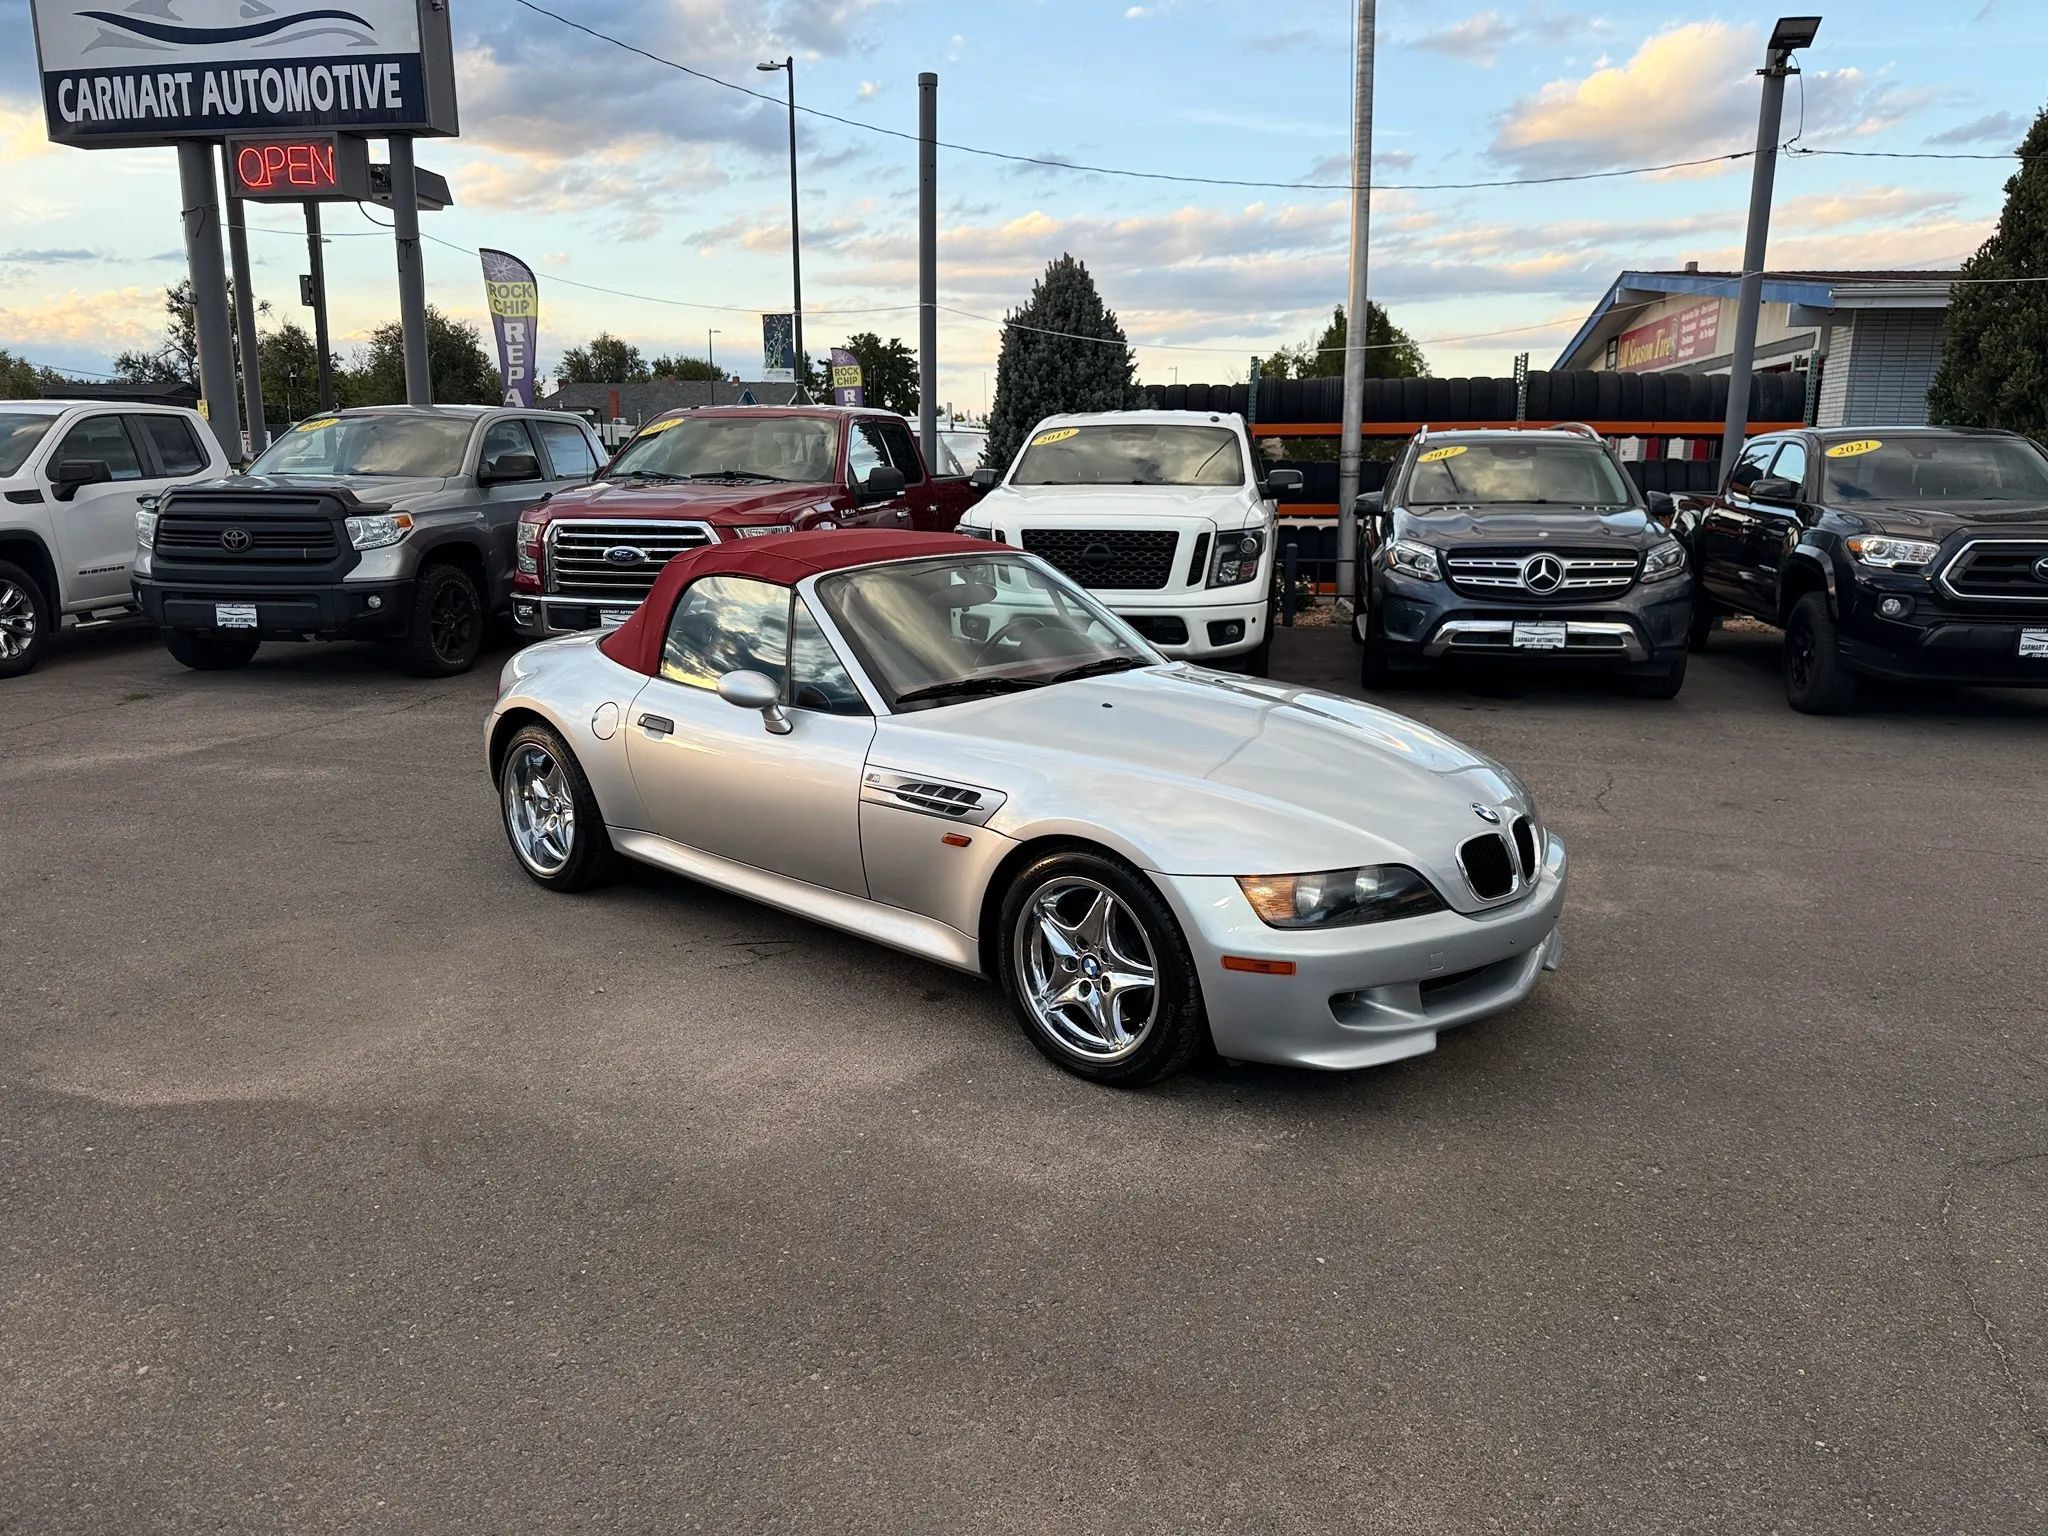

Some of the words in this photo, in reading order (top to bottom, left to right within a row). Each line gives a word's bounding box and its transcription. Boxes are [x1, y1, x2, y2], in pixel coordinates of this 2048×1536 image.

[58, 72, 193, 123] CARMART
[202, 63, 402, 116] AUTOMOTIVE
[237, 146, 335, 187] OPEN
[488, 283, 533, 299] ROCK
[493, 299, 530, 315] CHIP
[834, 367, 859, 377] ROCK
[836, 376, 858, 386] CHIP
[1040, 430, 1070, 443] 2019
[1426, 447, 1458, 460] 2017
[1838, 442, 1869, 455] 2021
[78, 565, 124, 575] SIERRA
